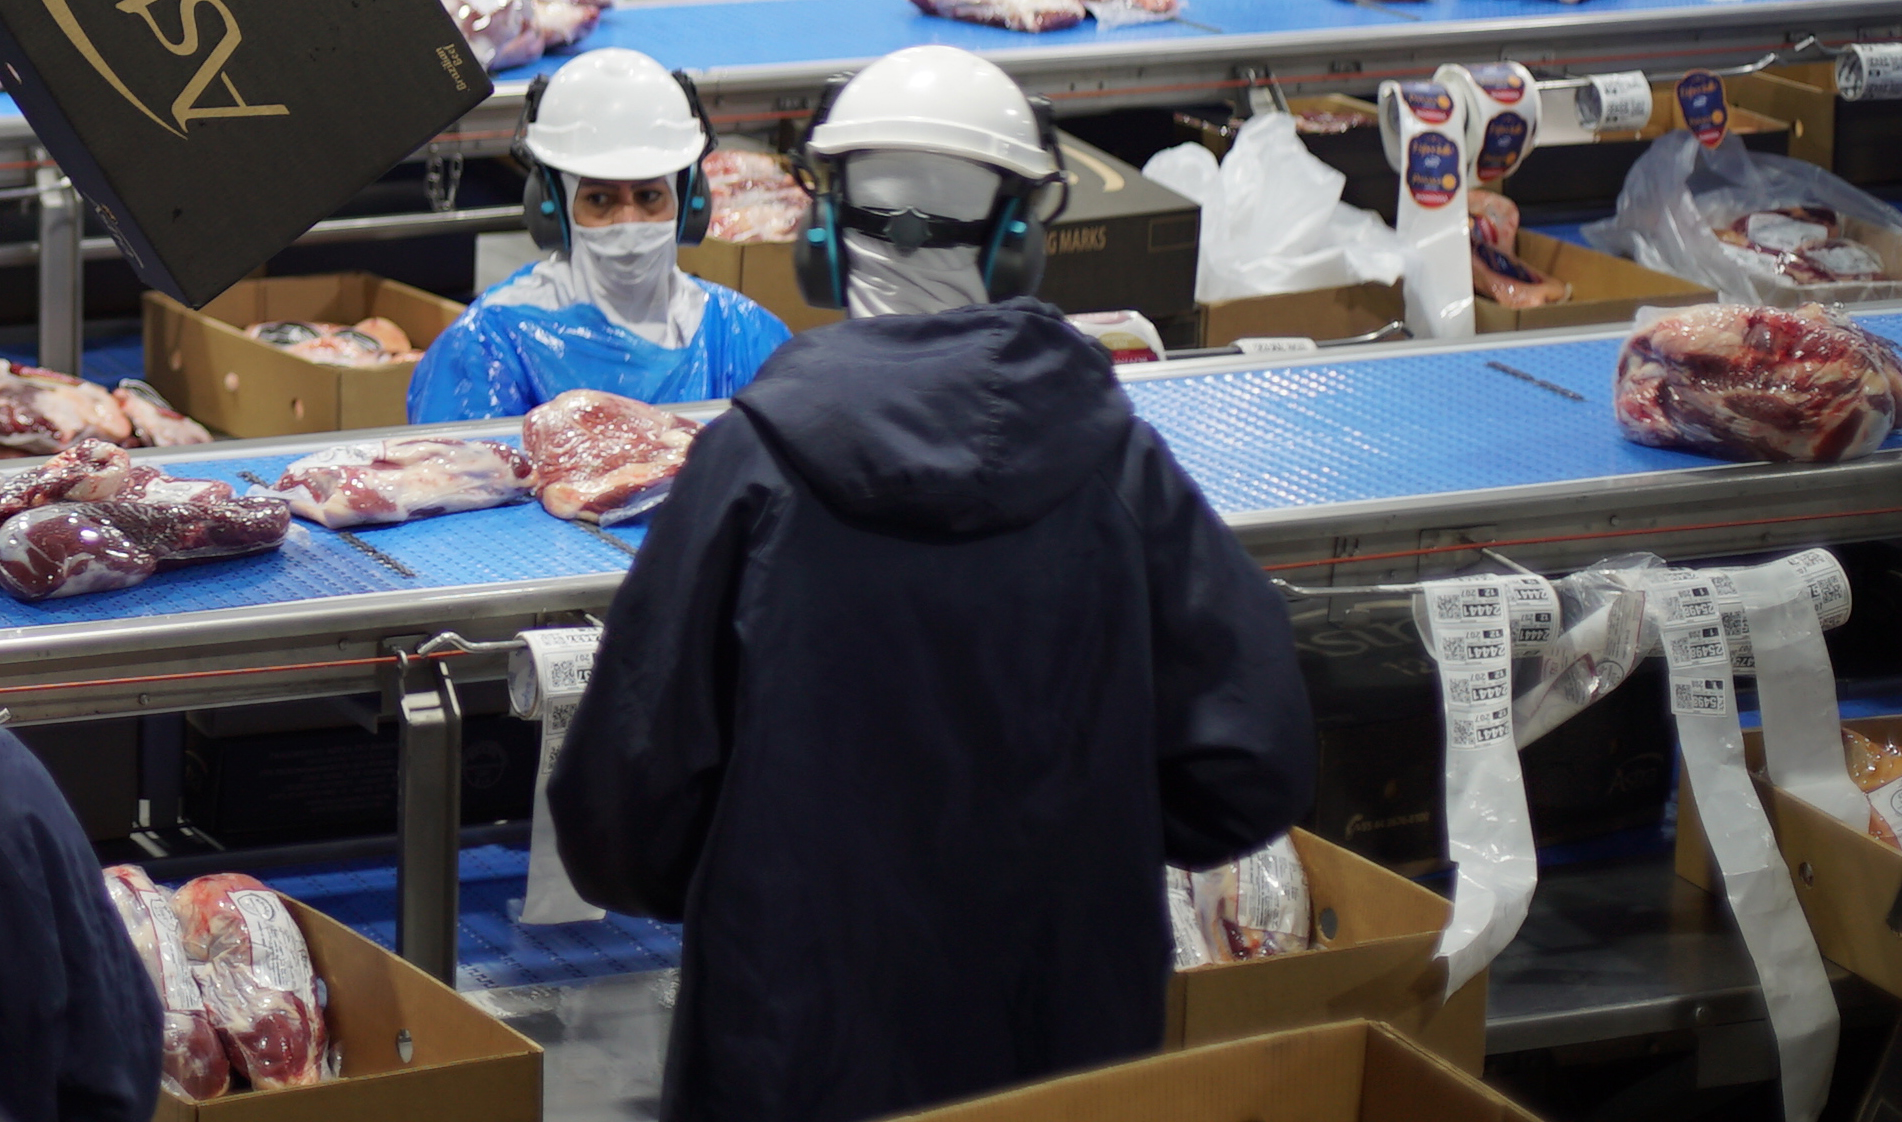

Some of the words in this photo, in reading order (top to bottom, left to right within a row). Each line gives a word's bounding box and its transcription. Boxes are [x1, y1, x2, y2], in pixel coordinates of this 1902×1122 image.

[1059, 227, 1107, 254] MARKS
[1463, 604, 1502, 617] 24441
[1467, 645, 1506, 659] 24441
[1472, 684, 1508, 701] 24441
